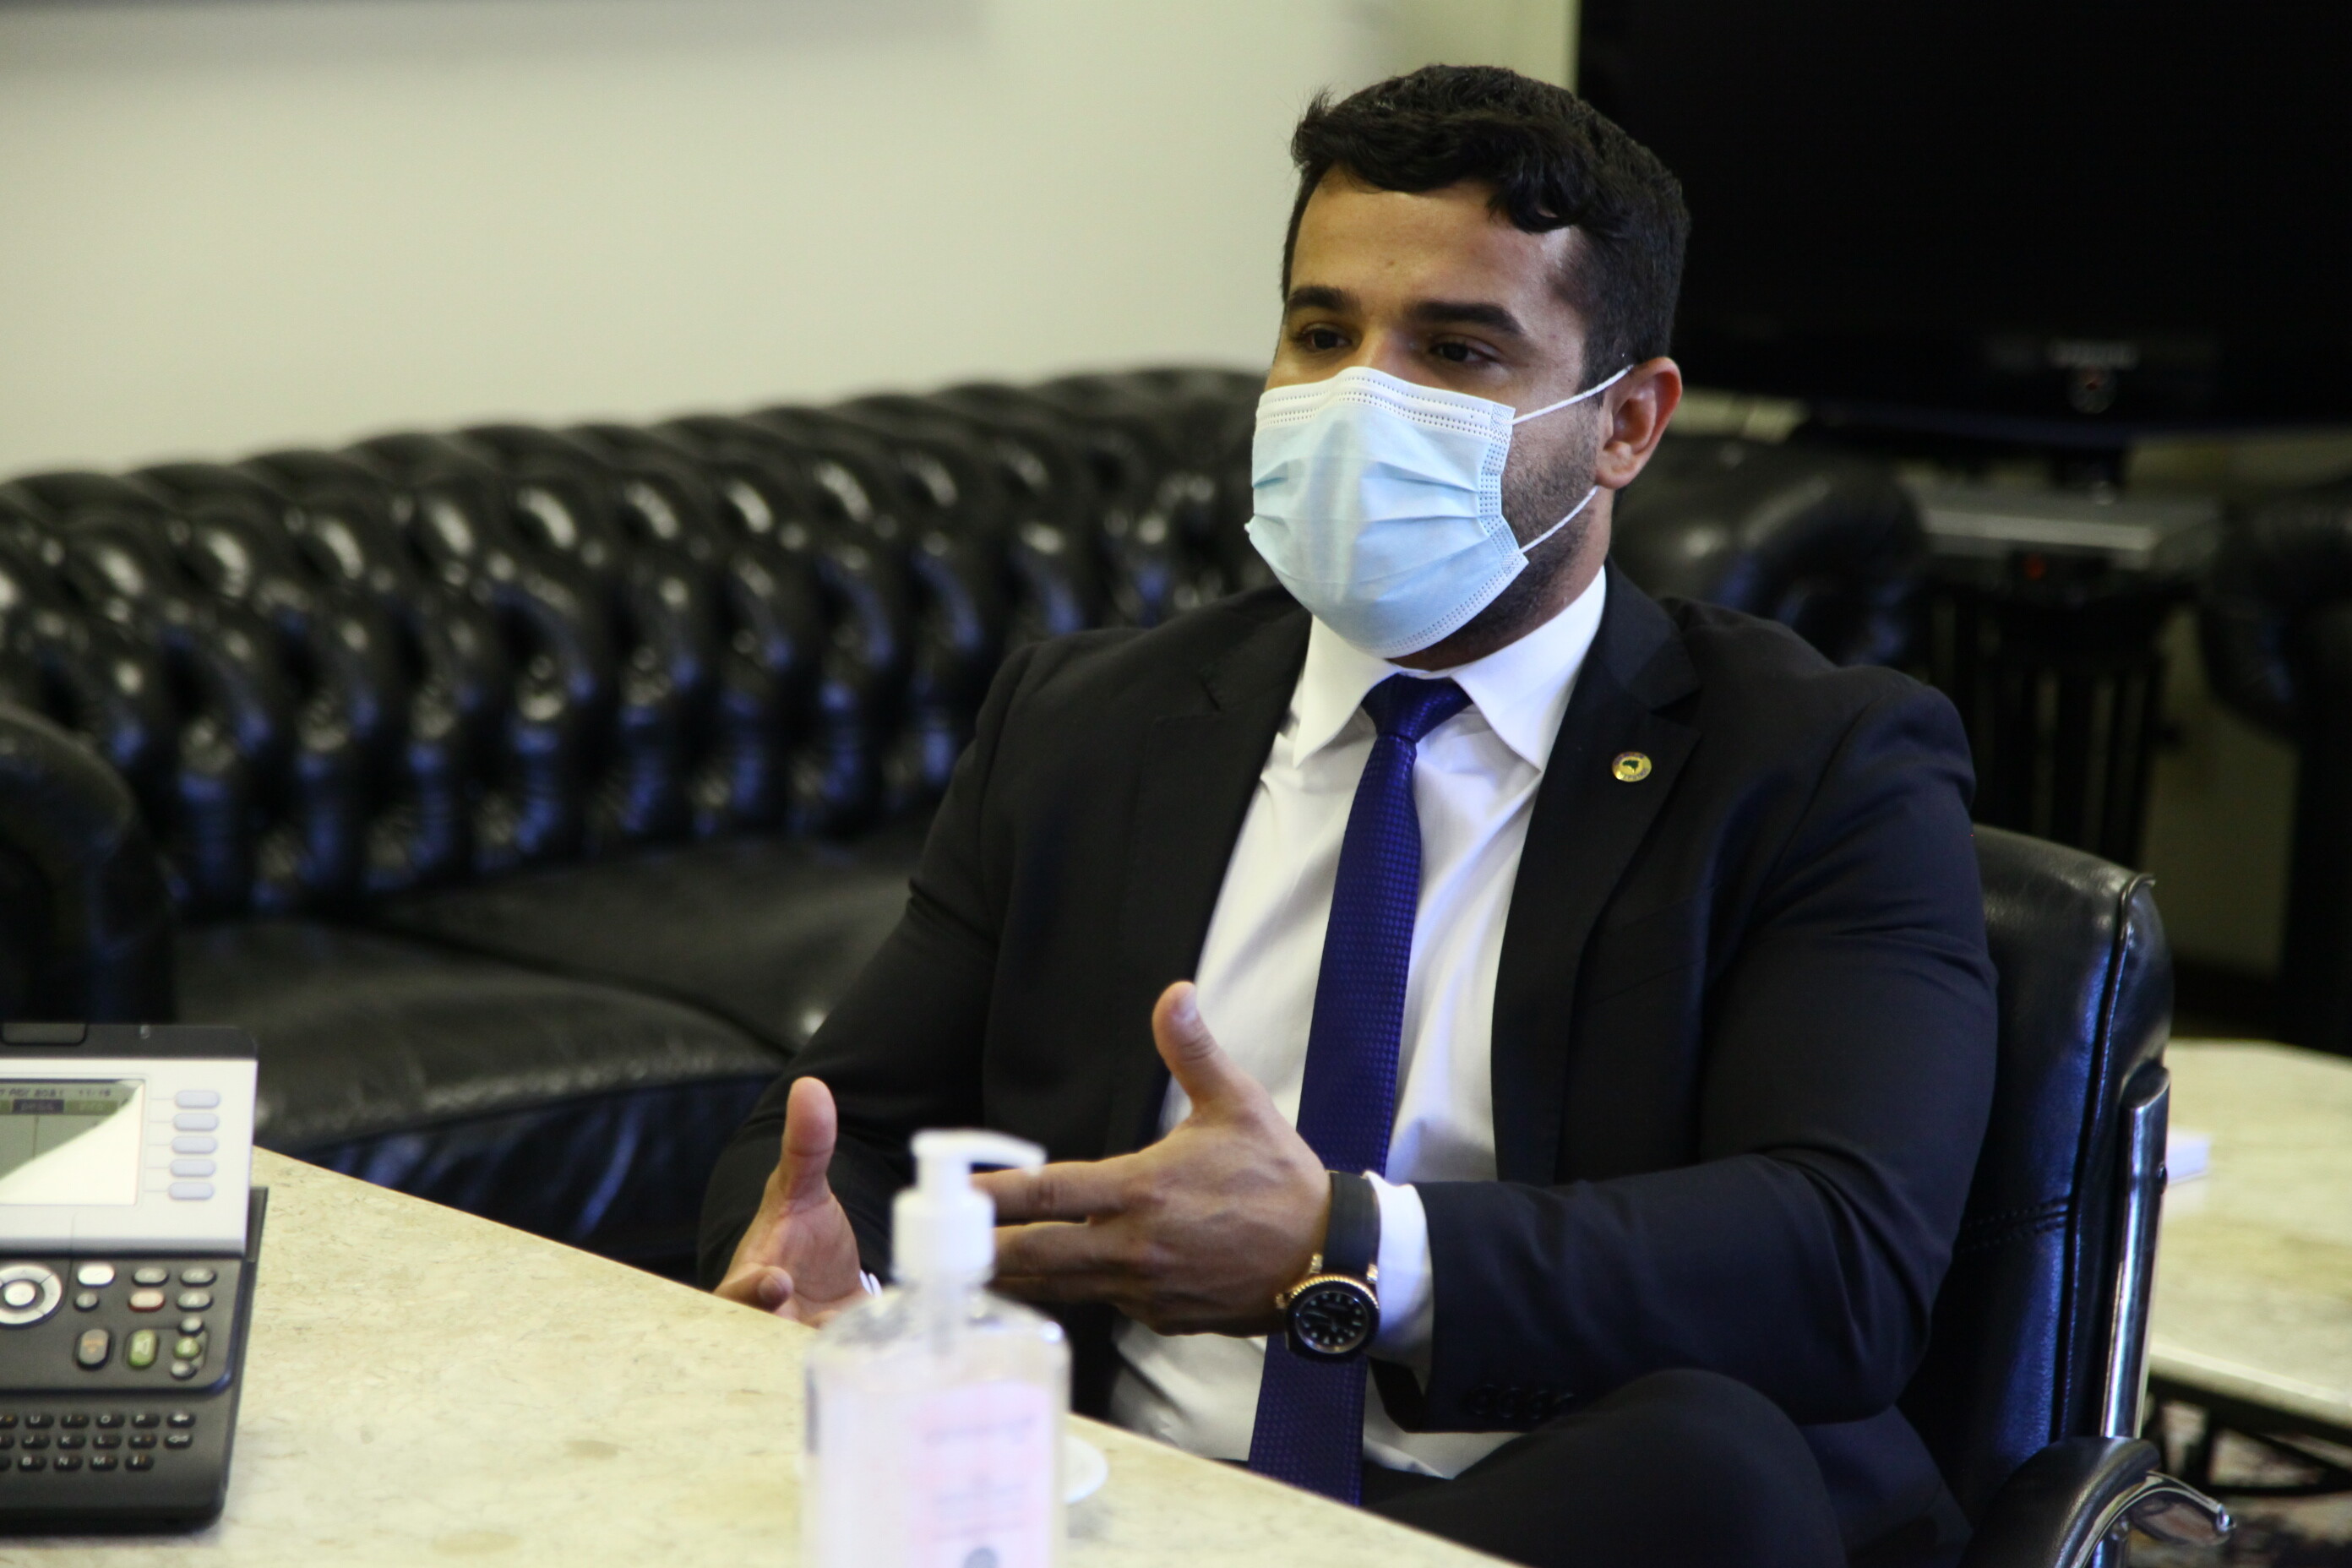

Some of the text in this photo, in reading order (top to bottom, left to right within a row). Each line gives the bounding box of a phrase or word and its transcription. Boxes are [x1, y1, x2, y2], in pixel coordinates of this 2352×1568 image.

[30, 1415, 41, 1424] U
[136, 1414, 146, 1424] P
[58, 1456, 69, 1466] N
[93, 1456, 106, 1466] M
